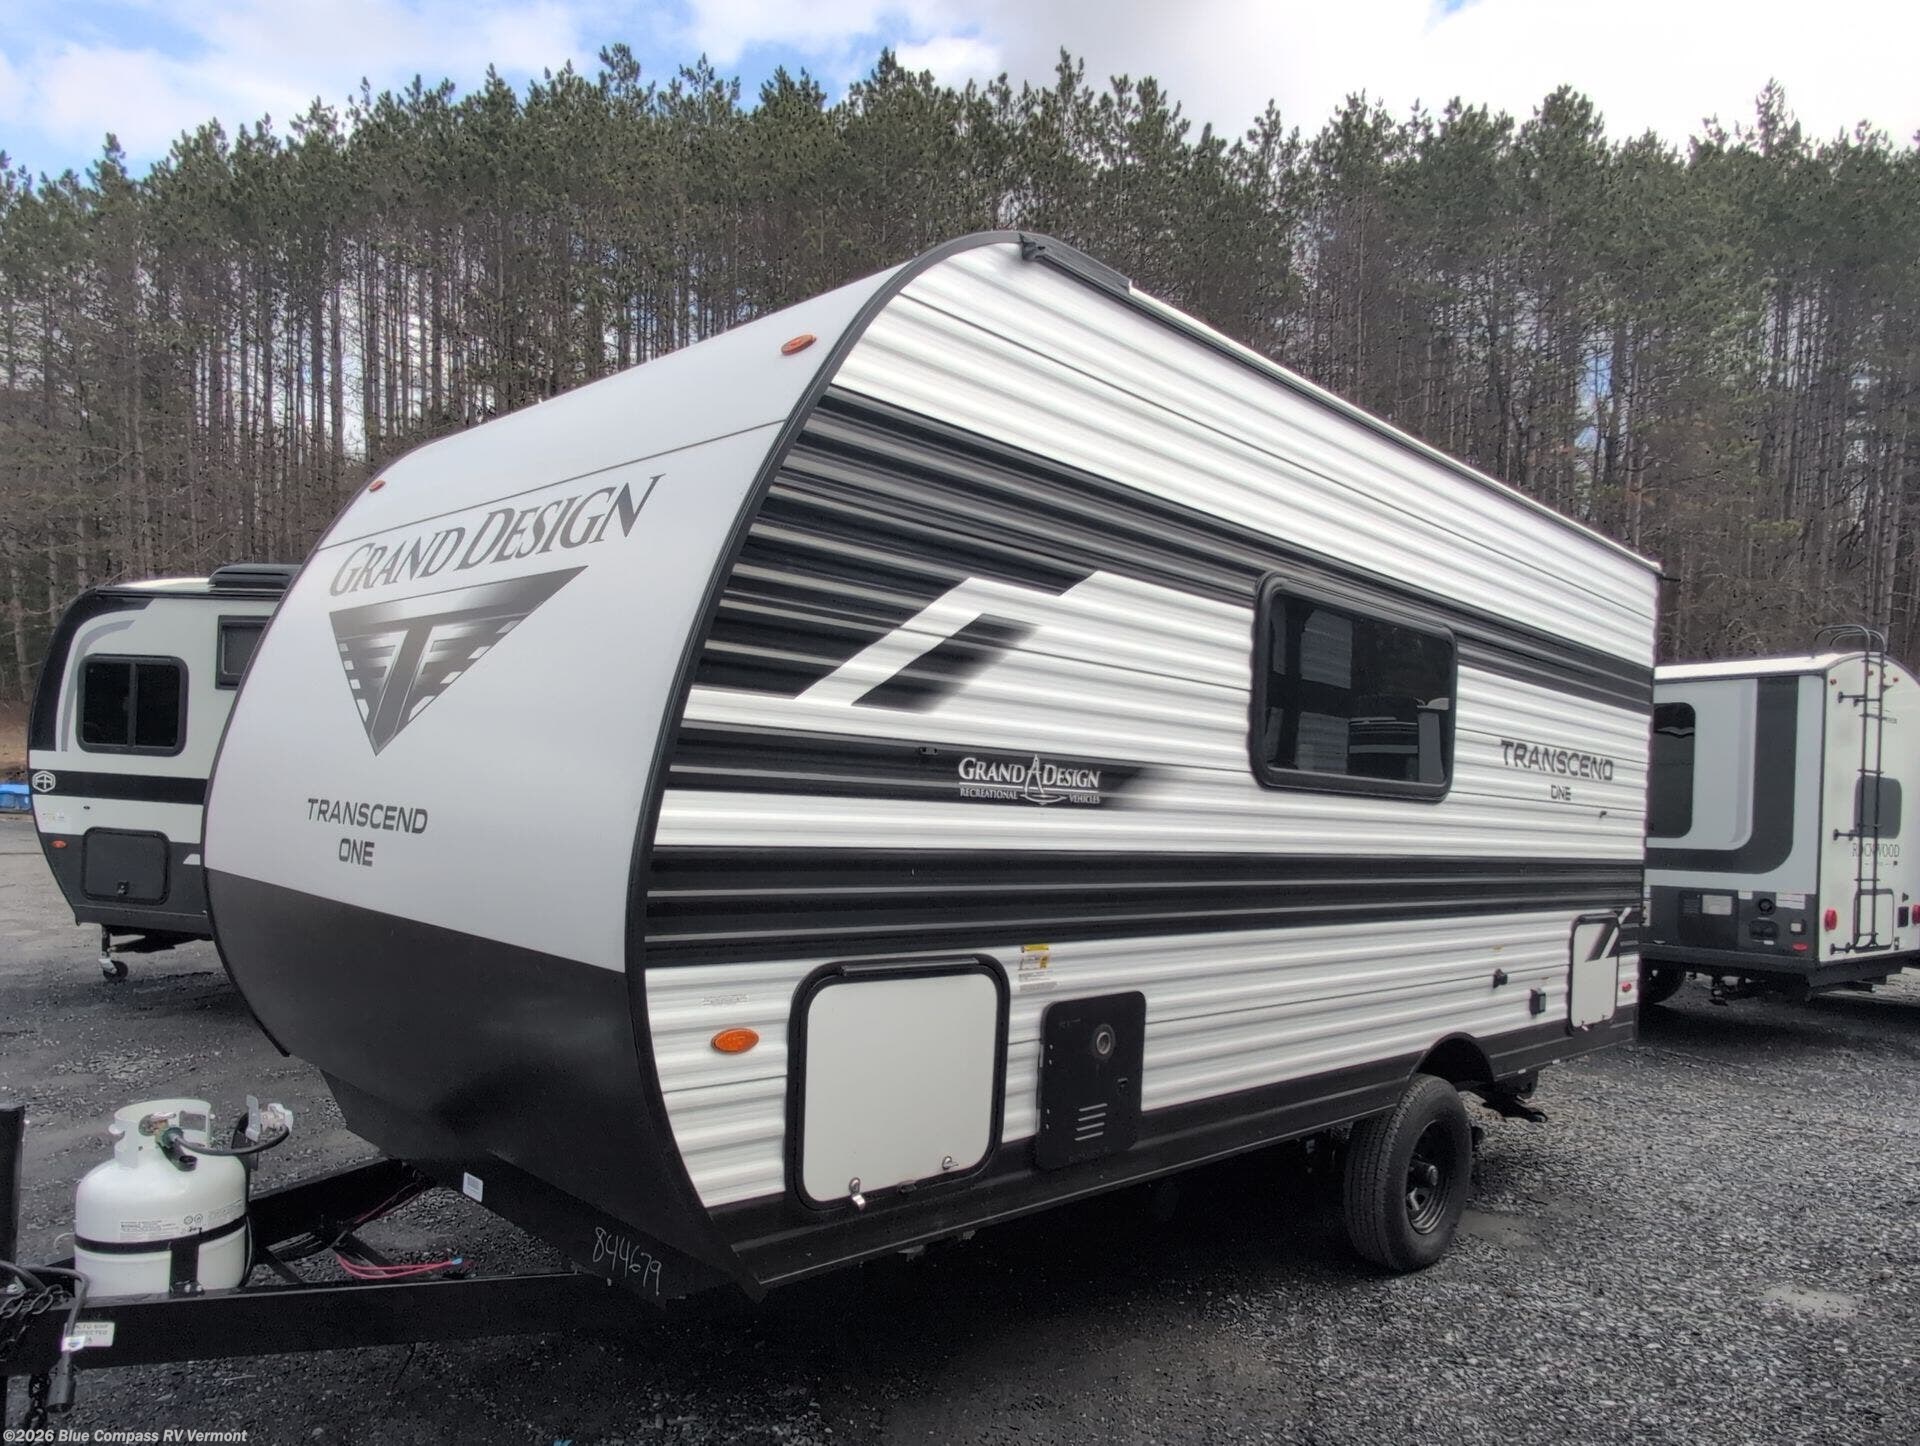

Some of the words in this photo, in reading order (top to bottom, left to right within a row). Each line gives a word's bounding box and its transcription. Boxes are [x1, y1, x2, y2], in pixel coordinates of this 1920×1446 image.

[329, 526, 467, 597] GRAND
[453, 473, 667, 571] DESIGN
[958, 757, 1025, 783] GRAND
[1042, 764, 1101, 788] DESIGN
[1500, 738, 1614, 782] TRANSCEND
[959, 787, 1019, 800] RECREATIONAL
[1069, 794, 1101, 804] VEHICLES
[1550, 785, 1572, 801] ONE
[307, 797, 428, 835] TRANSCEND
[338, 838, 375, 867] ONE
[592, 1226, 662, 1297] 844679
